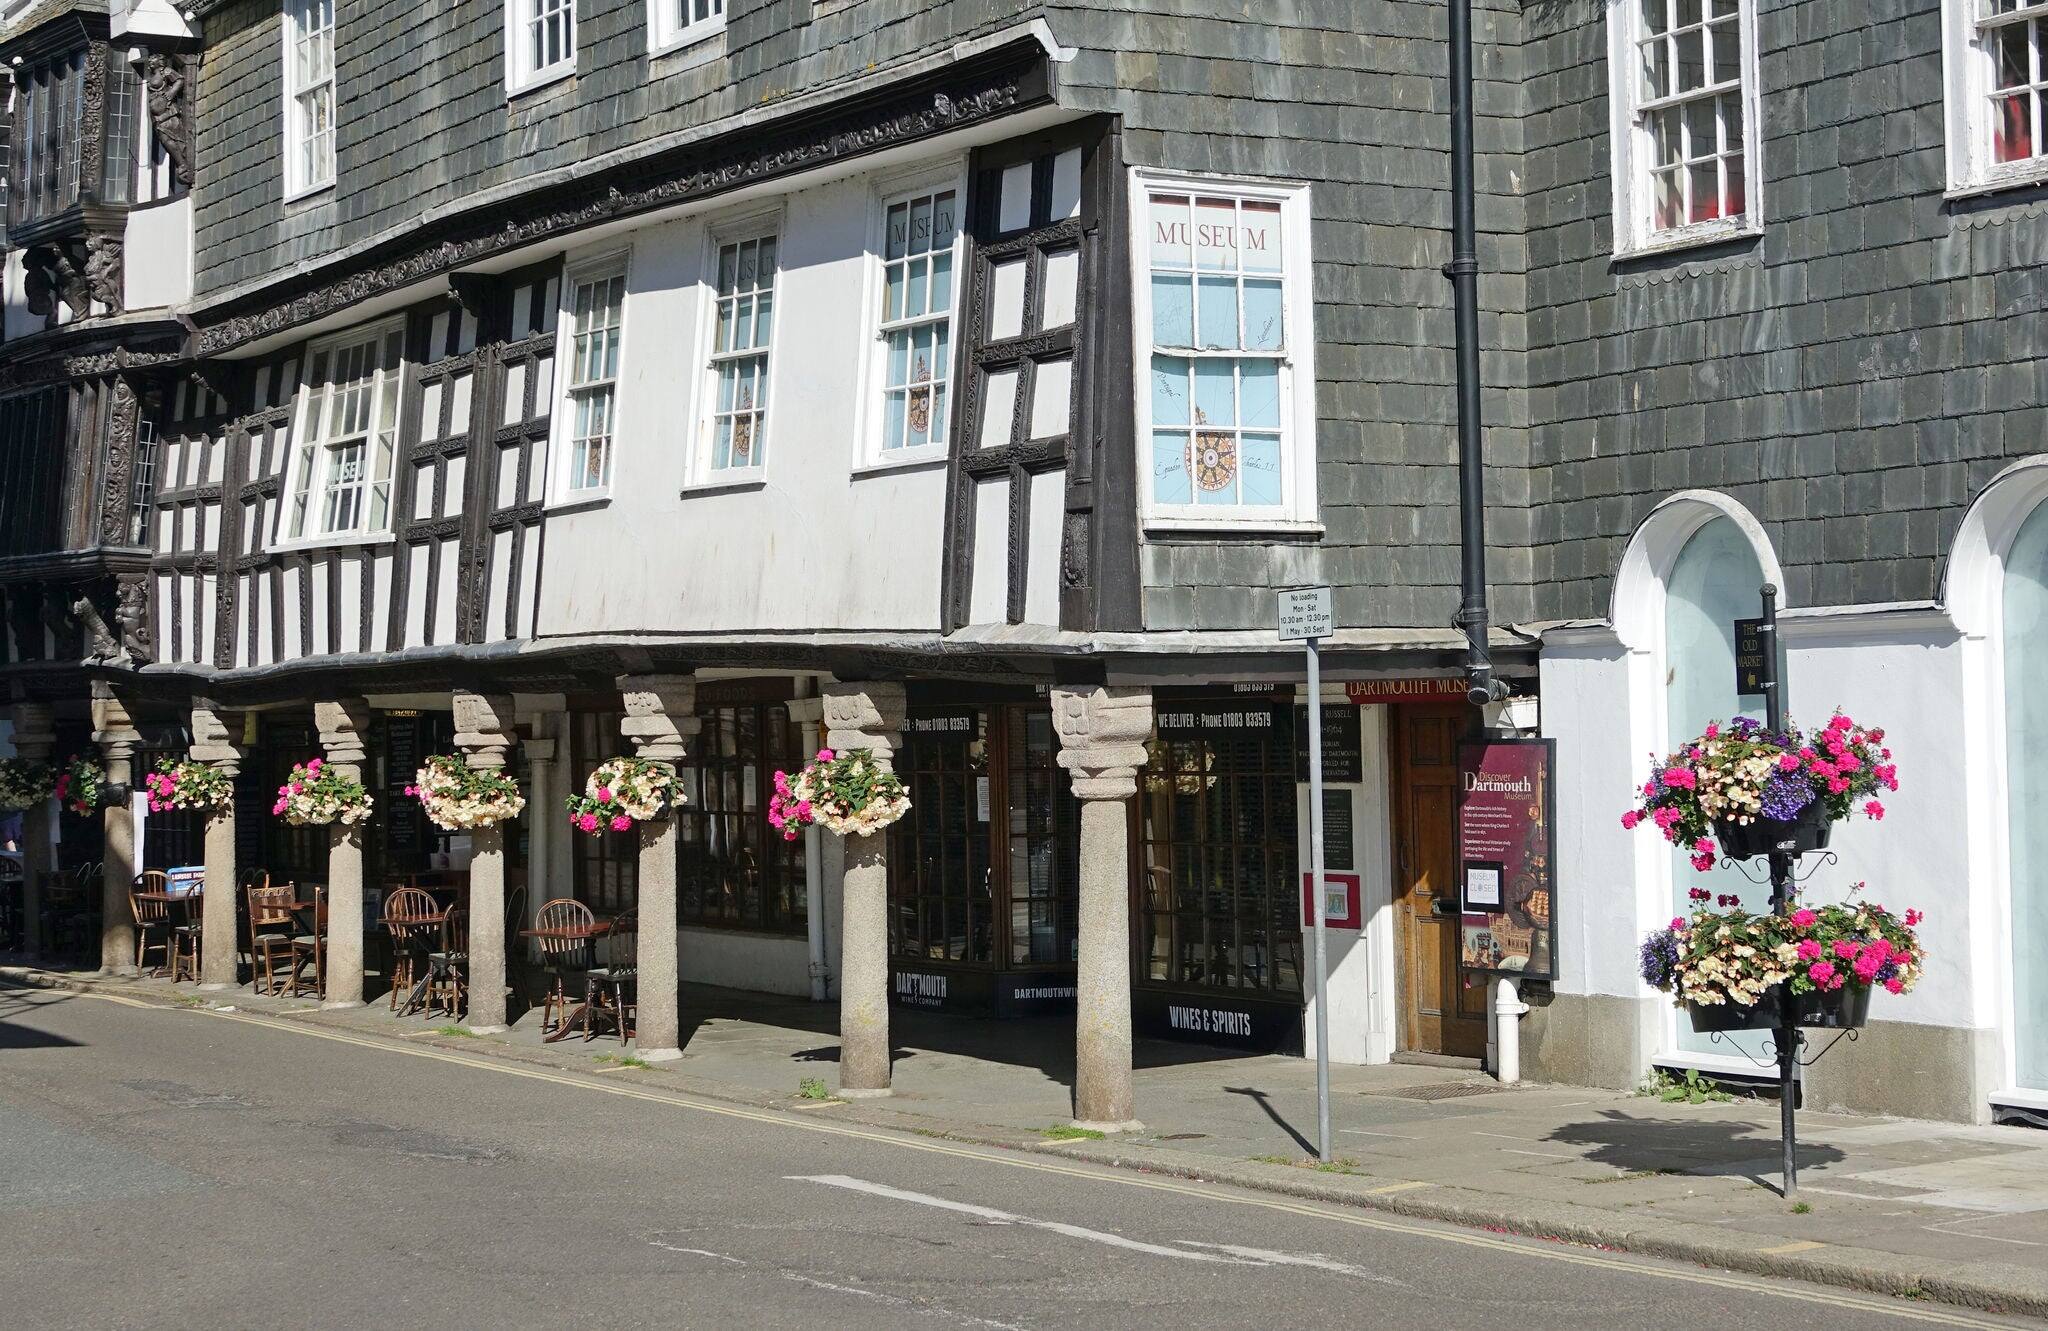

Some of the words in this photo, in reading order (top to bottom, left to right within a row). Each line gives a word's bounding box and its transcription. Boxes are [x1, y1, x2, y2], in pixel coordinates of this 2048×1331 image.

[1156, 221, 1267, 251] MUSEUM
[1350, 679, 1431, 696] DARTMOUTH
[1436, 679, 1471, 694] MUSE
[1158, 714, 1168, 728] WE
[1169, 714, 1195, 728] DELIVER
[1223, 713, 1243, 728] 01803
[1245, 712, 1271, 727] 833579
[1464, 772, 1532, 793] Dartmouth
[1479, 772, 1511, 782] Discover
[1503, 792, 1532, 801] Museum
[1470, 872, 1497, 881] MUSEUM
[896, 972, 948, 999] DARTMOUTH
[1169, 1006, 1202, 1031] WINES
[1203, 1009, 1211, 1032] &
[1212, 1010, 1252, 1037] SPIRITS
